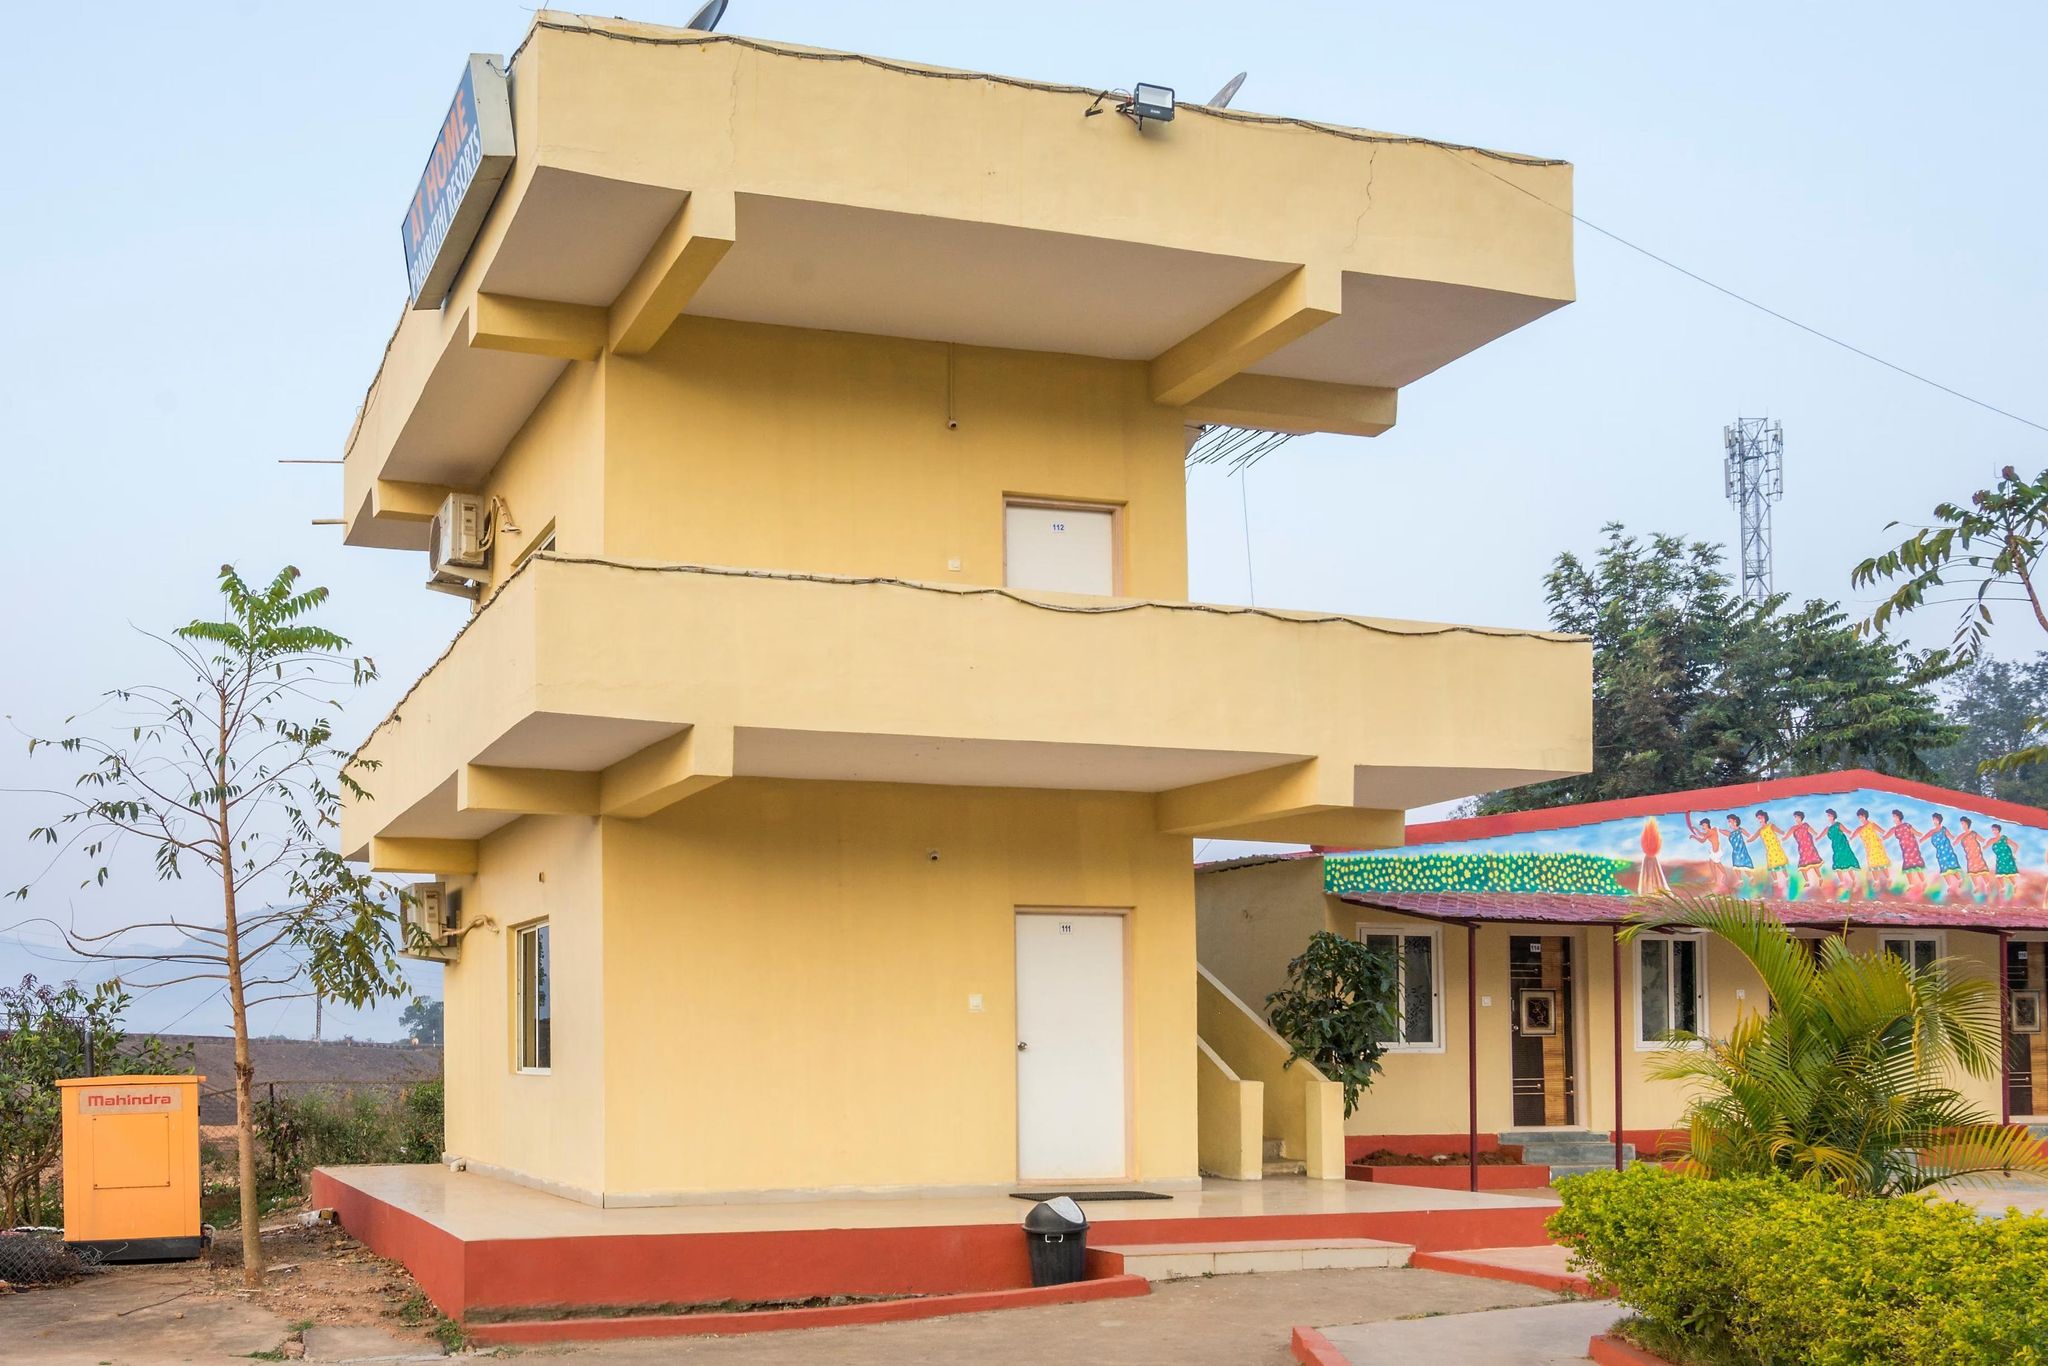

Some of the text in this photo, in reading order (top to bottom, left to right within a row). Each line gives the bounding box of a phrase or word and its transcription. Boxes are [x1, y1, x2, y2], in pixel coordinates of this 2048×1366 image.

[410, 123, 480, 299] PRAKRUTHI RESORTS
[411, 89, 468, 253] AT HOME
[88, 1094, 171, 1106] Mahindra
